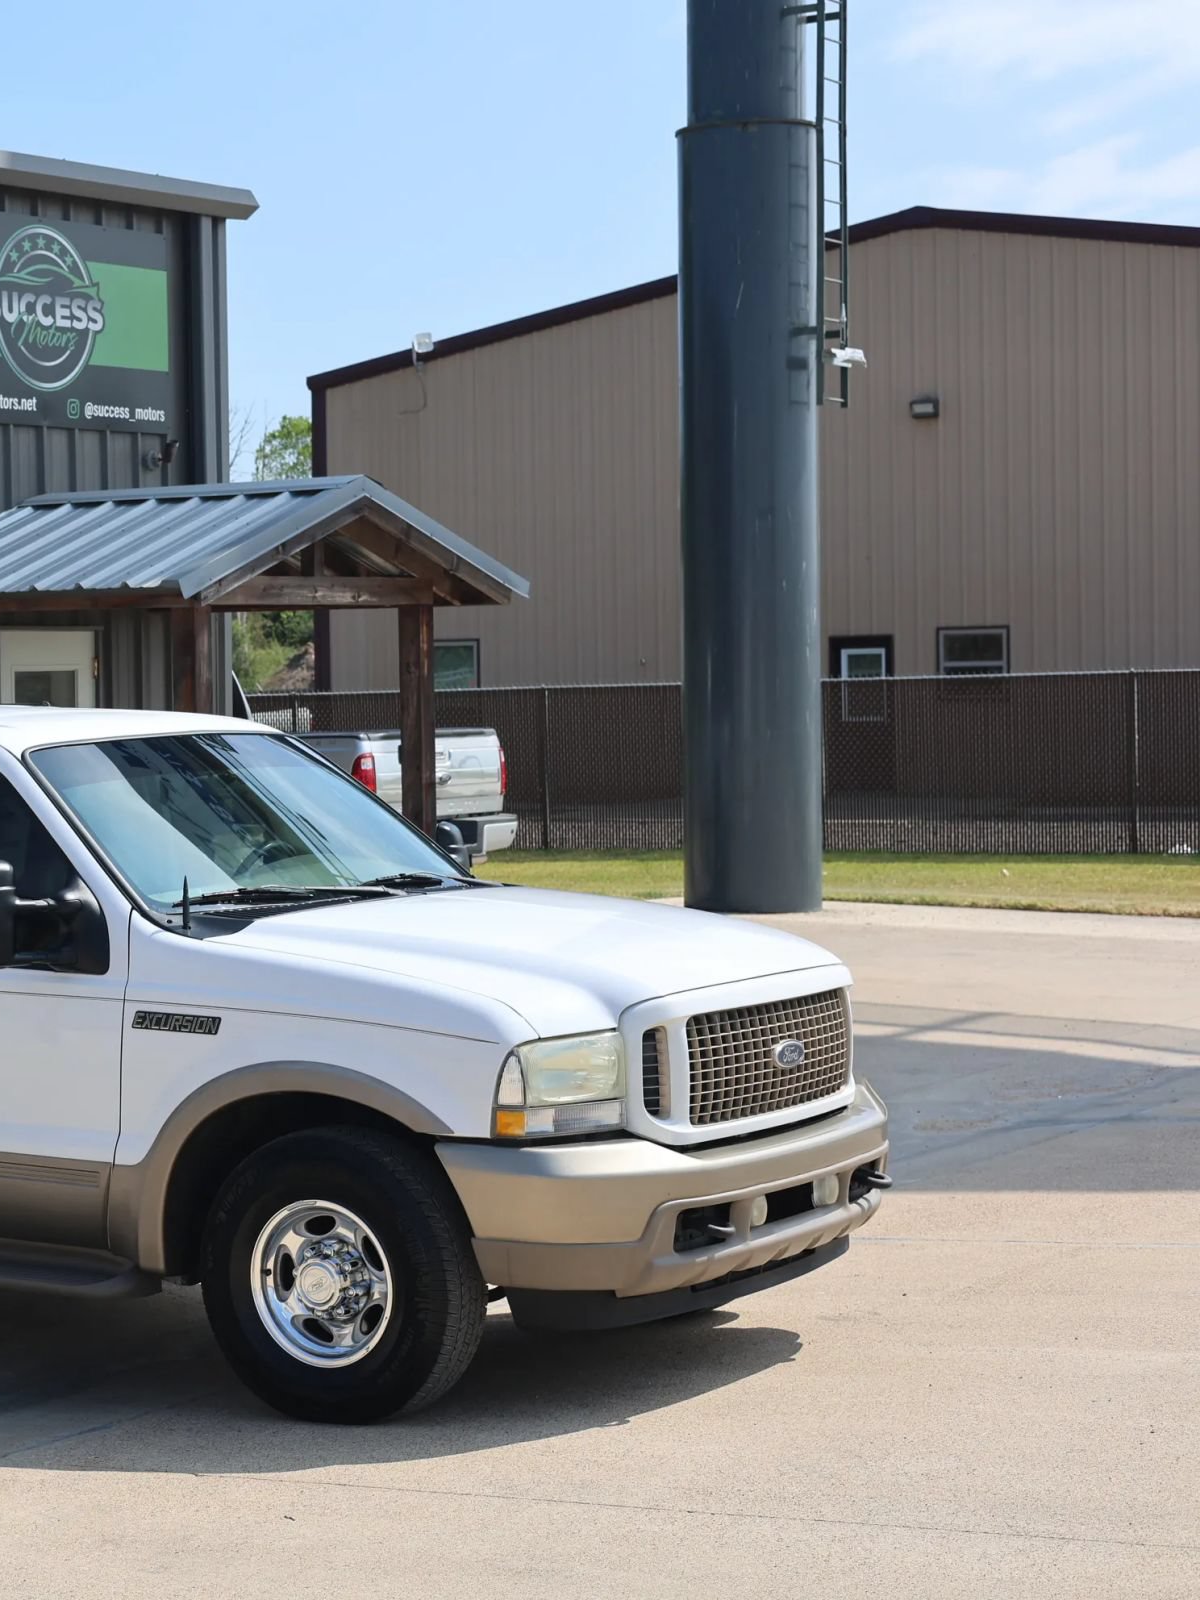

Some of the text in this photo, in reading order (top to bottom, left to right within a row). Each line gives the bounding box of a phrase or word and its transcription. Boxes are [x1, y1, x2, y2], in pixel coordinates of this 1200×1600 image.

[11, 311, 79, 350] Motors
[84, 402, 165, 422] @success_motors
[132, 1012, 220, 1034] EXCURSION
[782, 1046, 799, 1062] Ford
